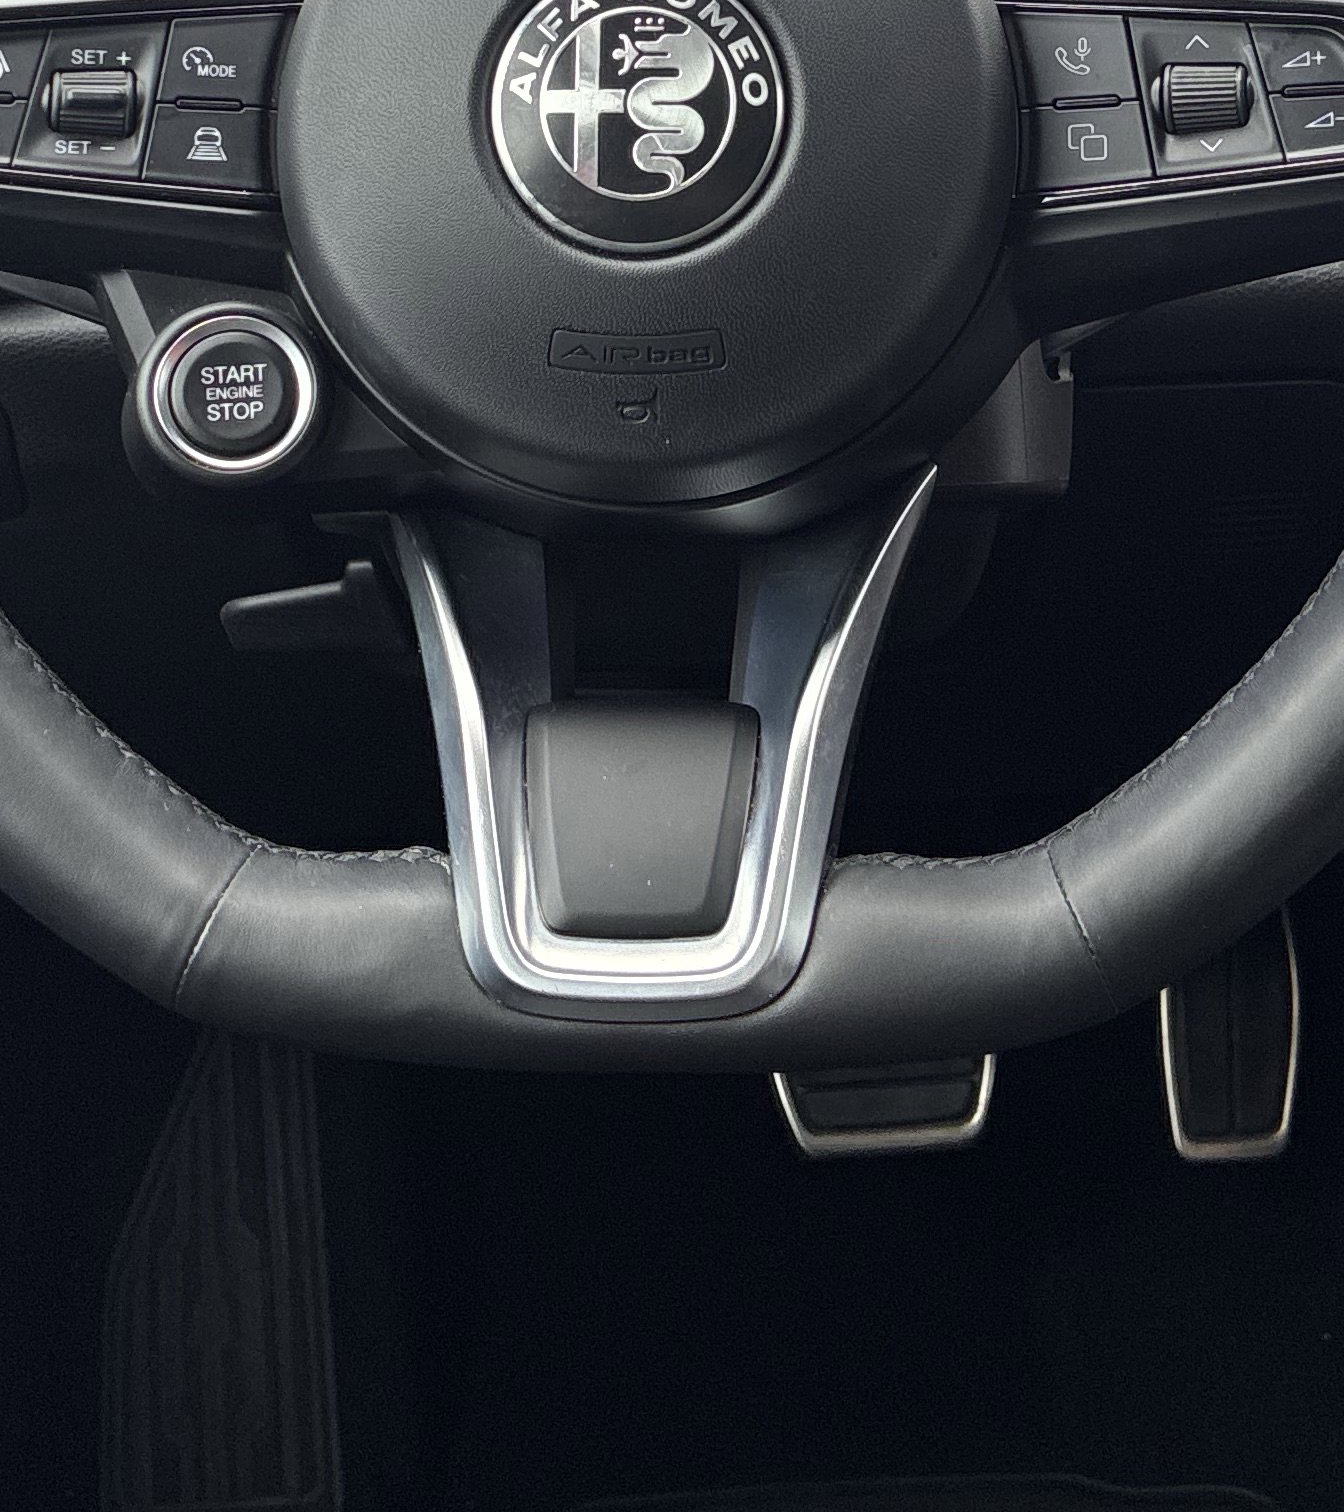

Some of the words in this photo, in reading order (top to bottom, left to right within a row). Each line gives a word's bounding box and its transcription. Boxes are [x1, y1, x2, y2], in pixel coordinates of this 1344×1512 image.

[71, 49, 107, 65] SET
[197, 65, 237, 77] MODE
[55, 140, 91, 155] SET
[200, 363, 267, 385] START
[206, 385, 263, 401] ENGINE
[207, 401, 264, 422] STOP
